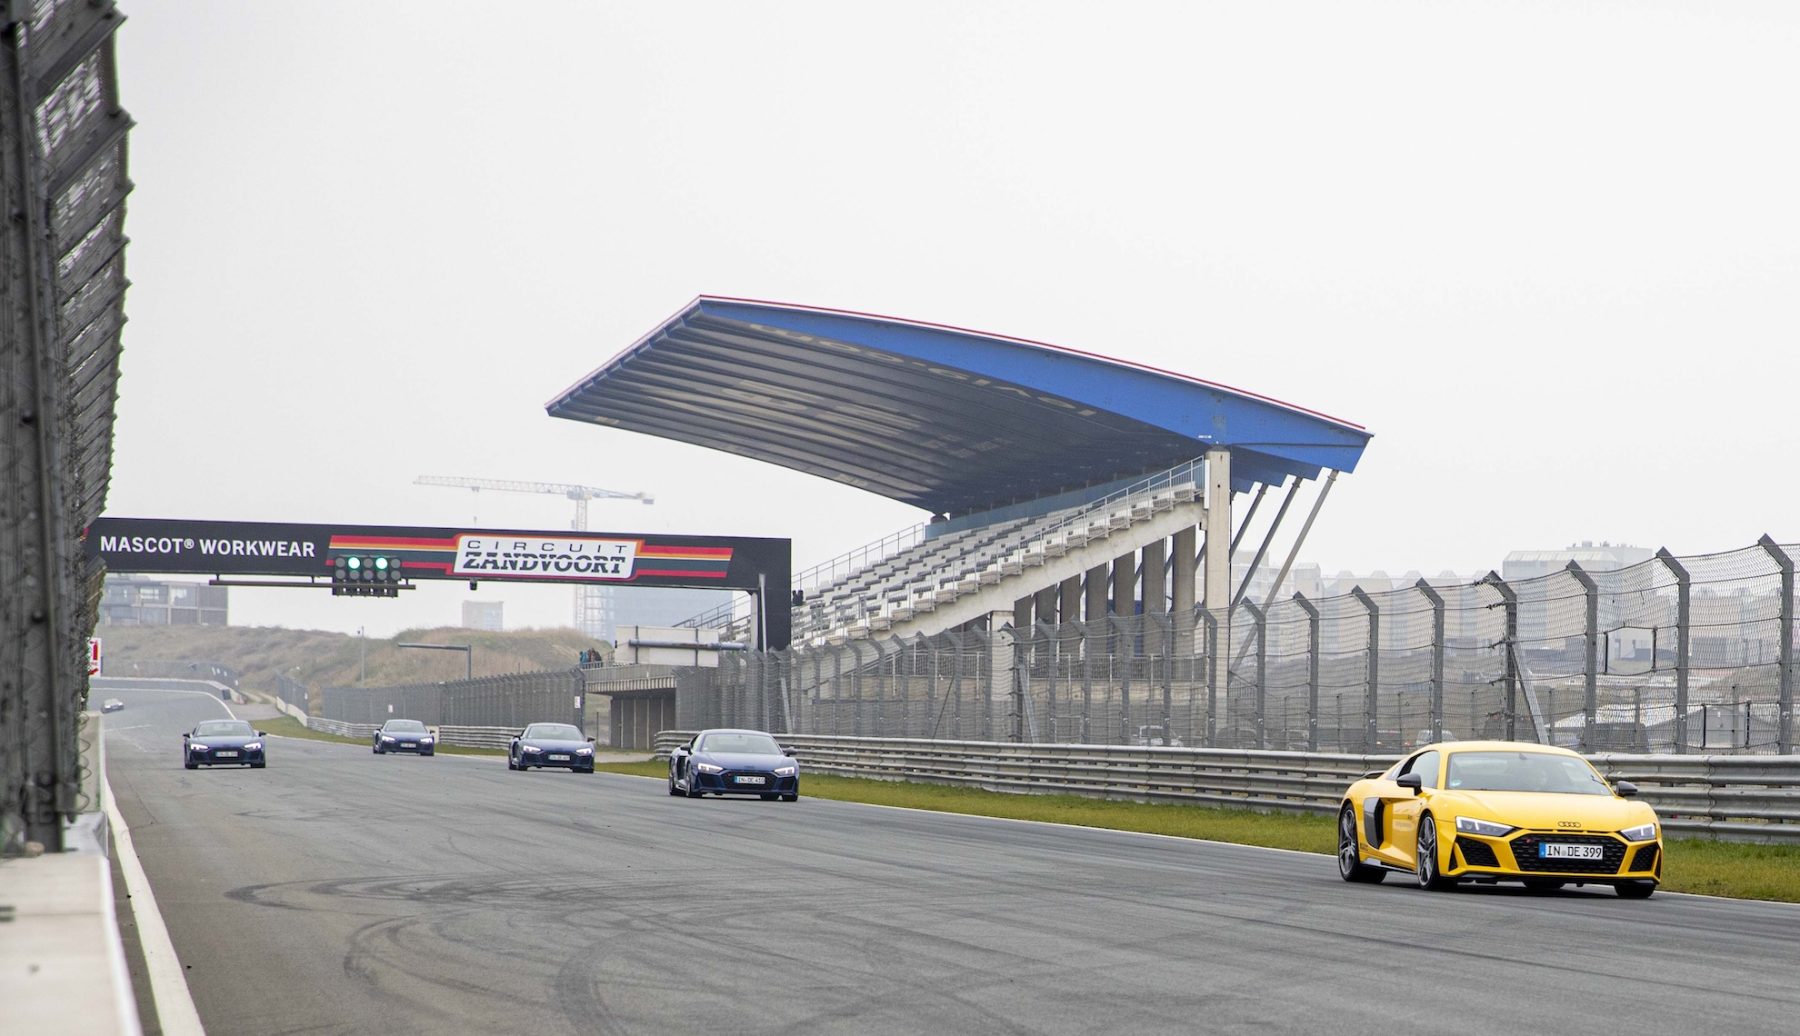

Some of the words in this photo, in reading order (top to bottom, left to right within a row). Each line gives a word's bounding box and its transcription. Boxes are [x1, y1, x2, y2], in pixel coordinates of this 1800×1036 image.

[199, 539, 315, 558] WORKWEAR
[467, 540, 627, 554] CIRCUIT
[463, 551, 626, 574] ZANDVOORT
[1547, 845, 1561, 856] IN
[1567, 846, 1581, 857] DE
[1583, 847, 1602, 858] 399
